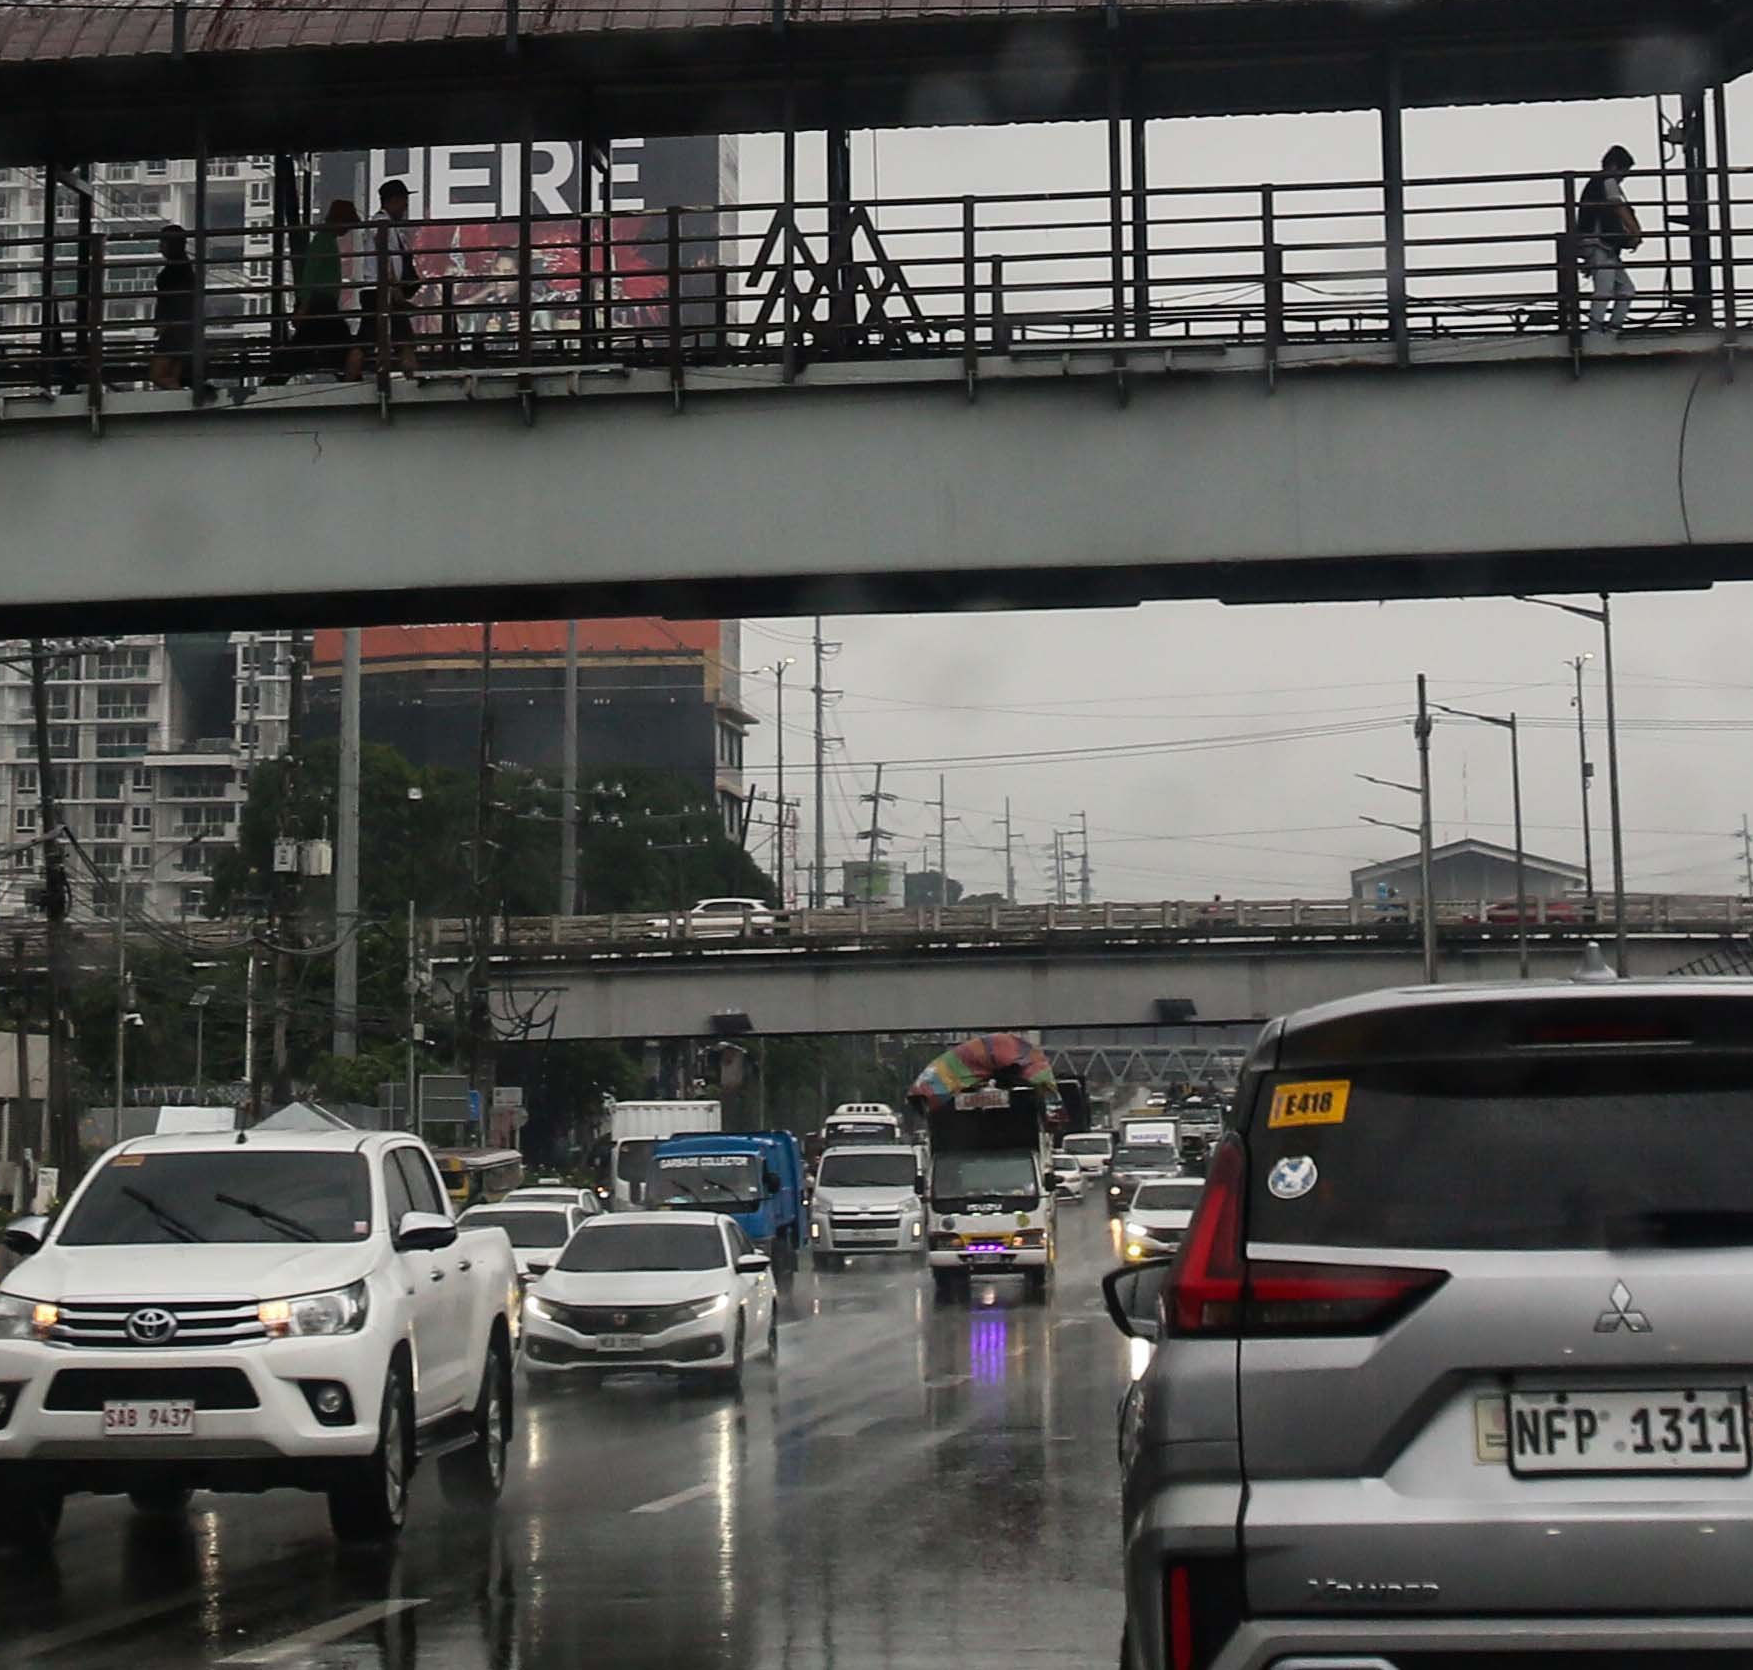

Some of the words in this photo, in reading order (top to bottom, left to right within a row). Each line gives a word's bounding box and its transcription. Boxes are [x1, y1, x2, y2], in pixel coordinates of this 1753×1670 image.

[369, 137, 645, 221] HERE
[1515, 1408, 1597, 1456] NFP
[1630, 1407, 1742, 1454] 1311
